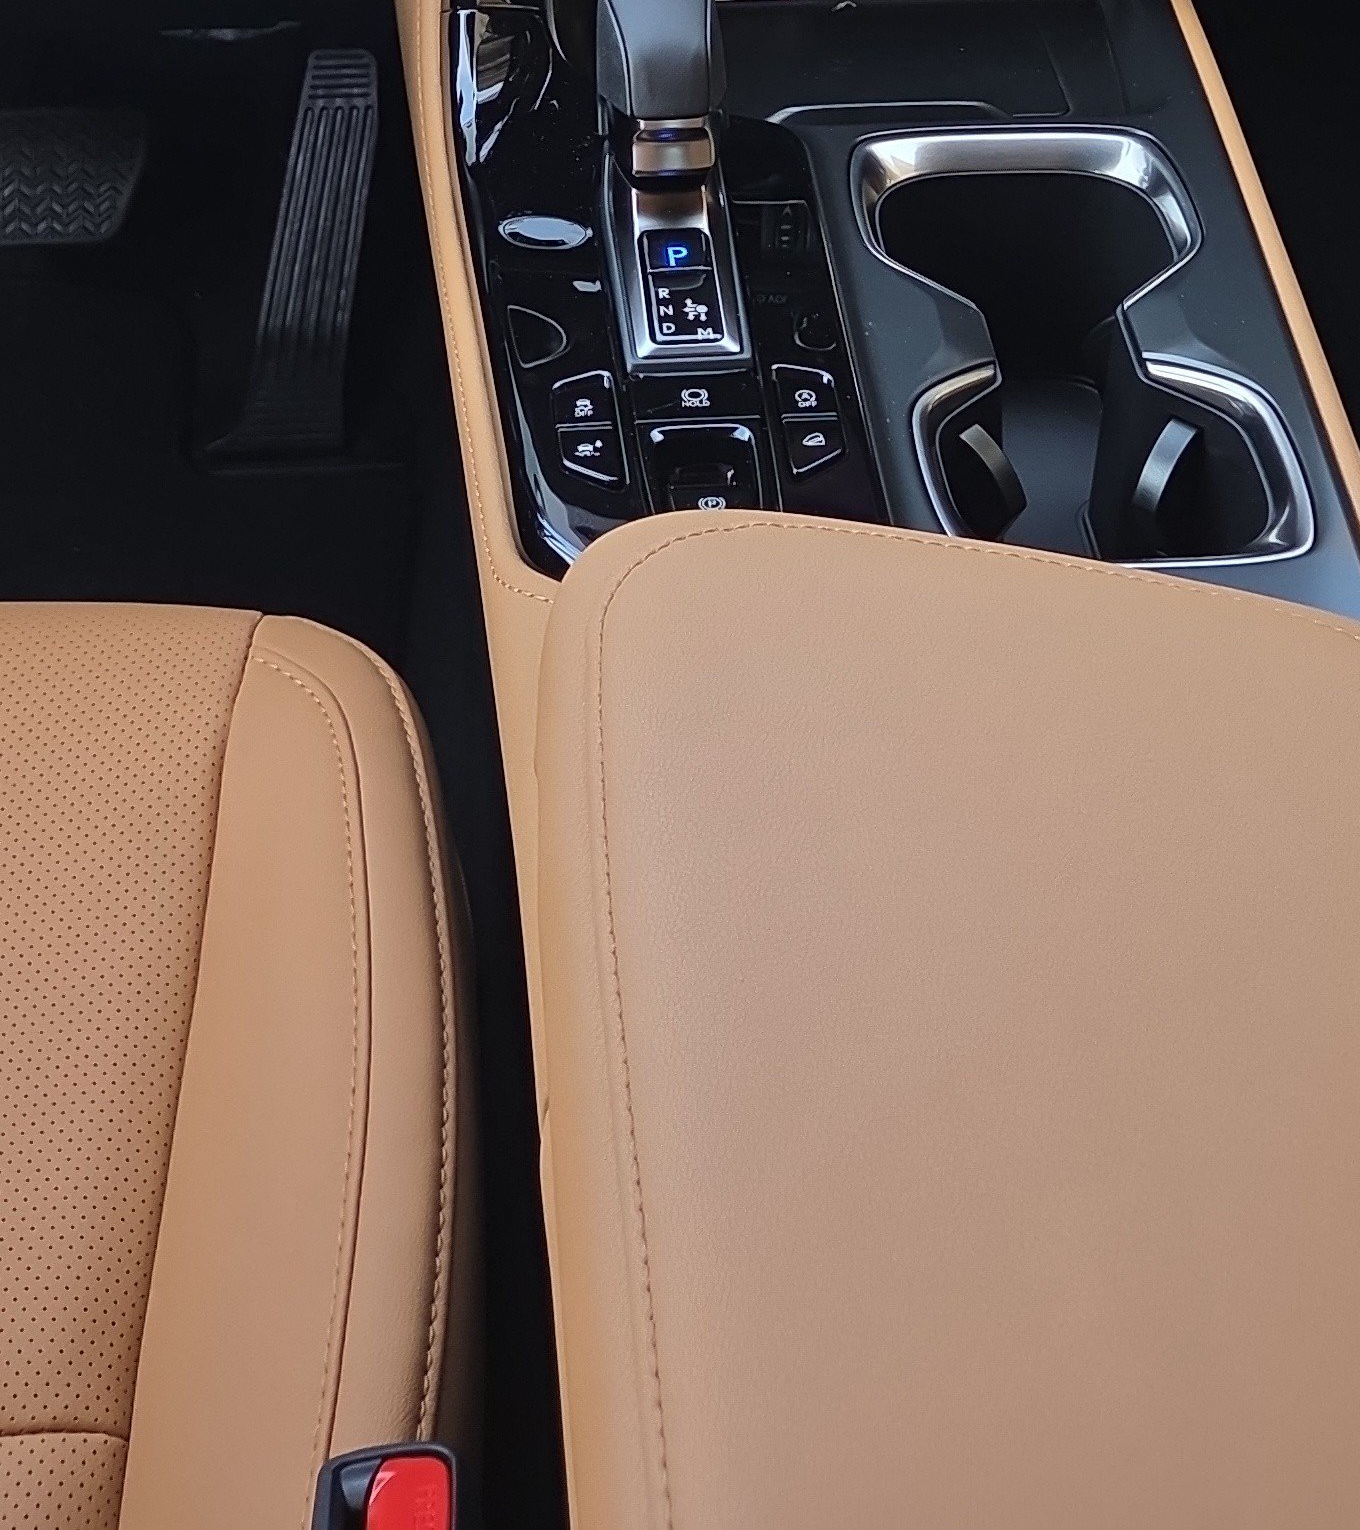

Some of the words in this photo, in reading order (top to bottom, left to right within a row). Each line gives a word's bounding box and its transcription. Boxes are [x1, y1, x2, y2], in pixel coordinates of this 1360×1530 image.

[667, 246, 689, 267] P
[657, 287, 671, 299] R
[659, 304, 674, 317] N
[661, 322, 676, 334] D
[696, 327, 714, 340] M
